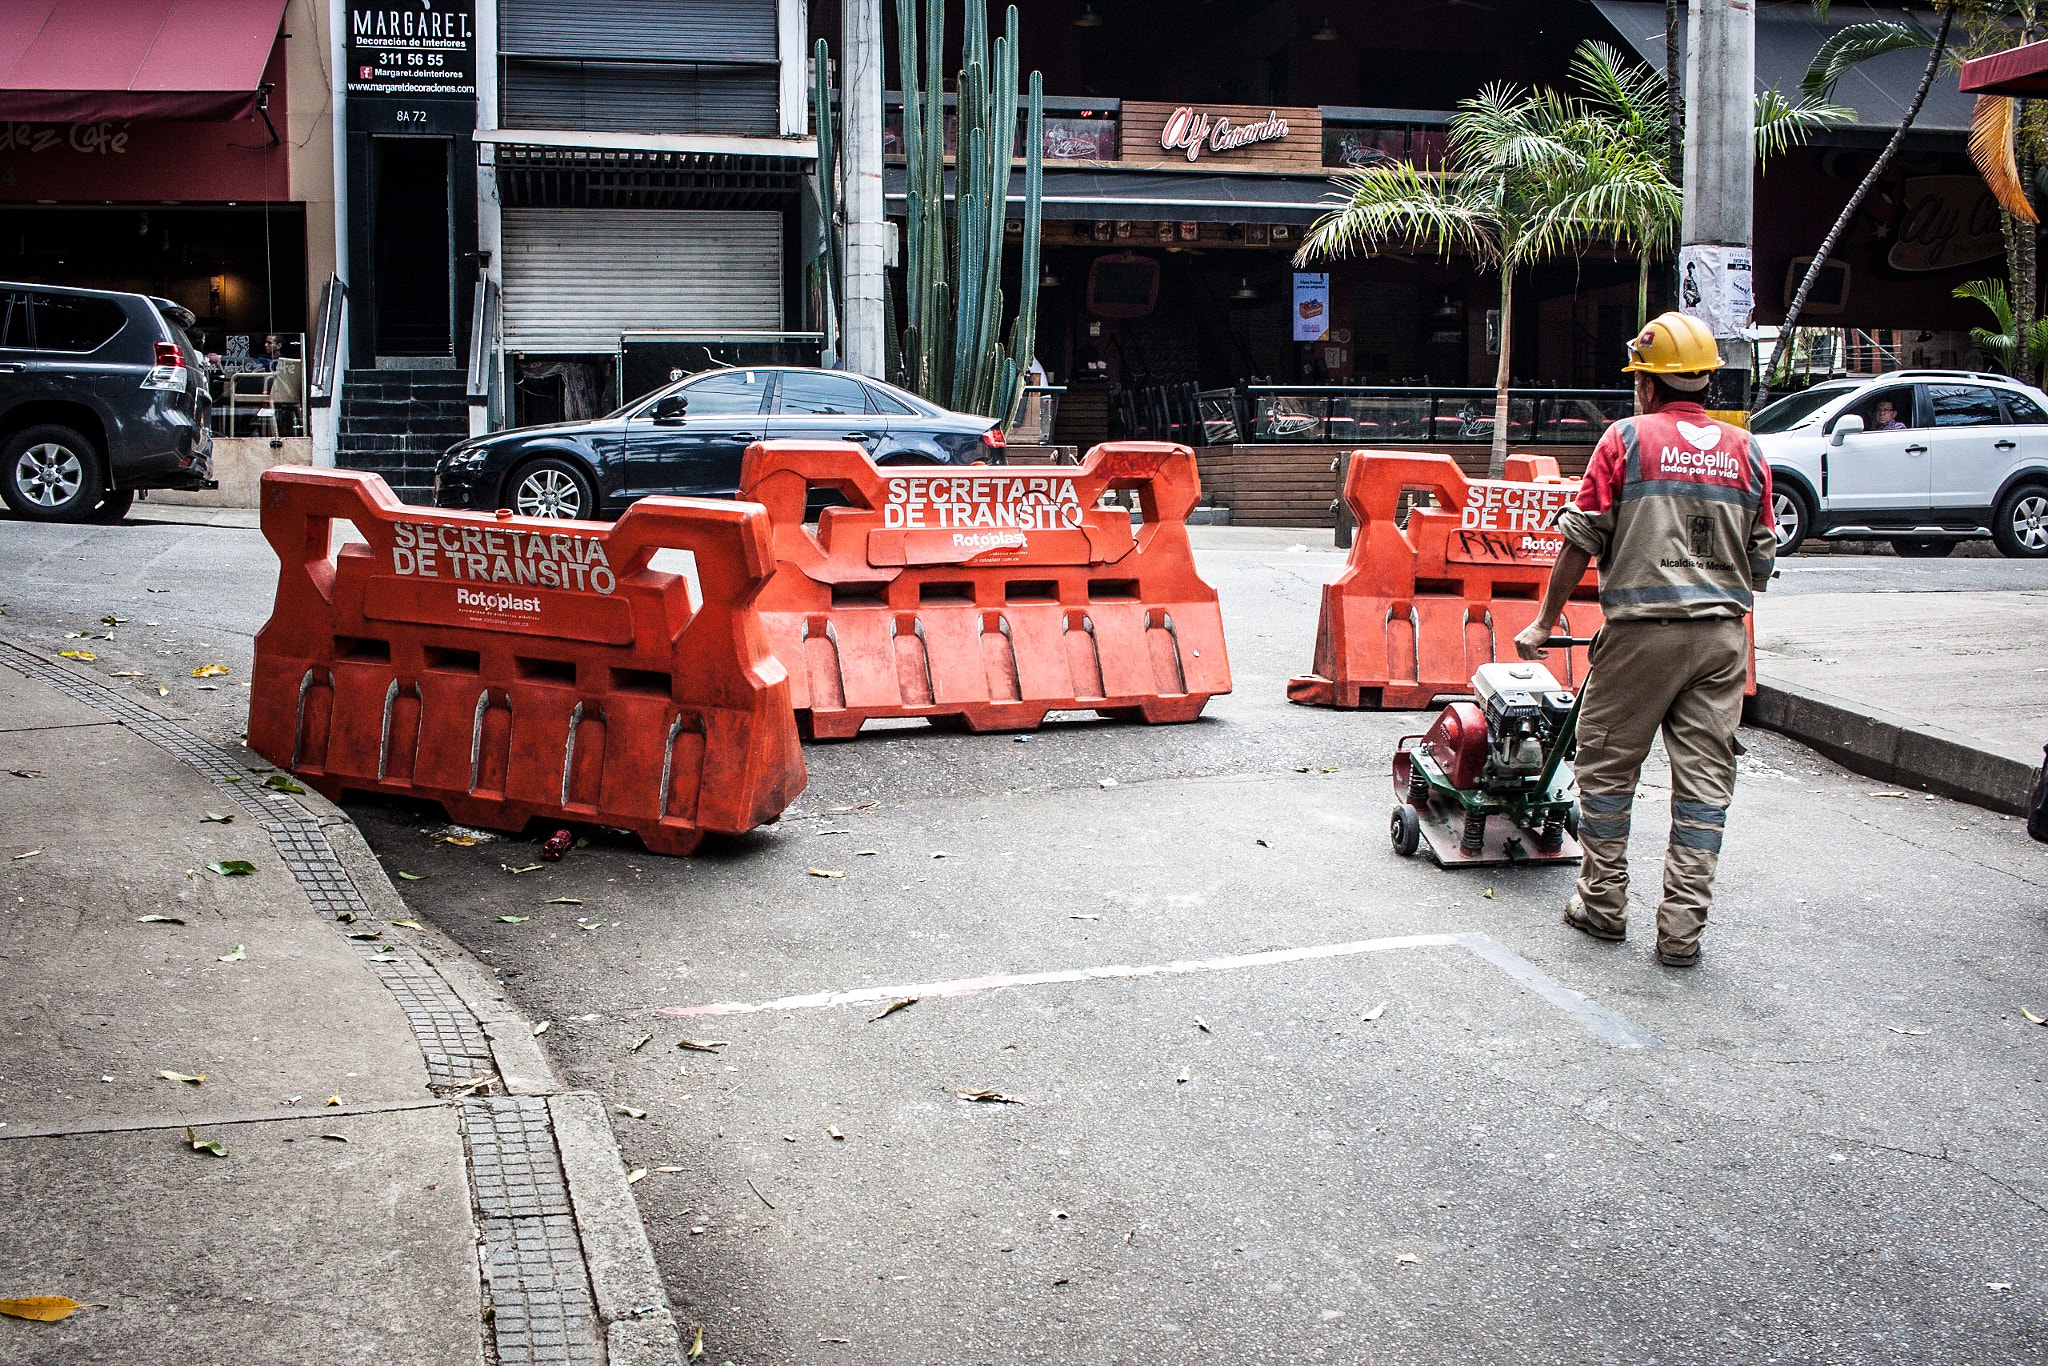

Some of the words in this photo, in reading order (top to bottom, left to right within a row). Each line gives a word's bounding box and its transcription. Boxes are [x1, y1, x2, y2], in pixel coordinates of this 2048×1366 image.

[353, 10, 468, 37] MARGARET
[356, 36, 407, 46] Decoración
[408, 38, 421, 47] de
[422, 38, 467, 48] Interiores
[379, 52, 402, 65] 311
[407, 53, 424, 66] 56
[427, 54, 444, 67] 55
[347, 82, 475, 94] www.margaretdecoraciones.com
[396, 110, 410, 122] 8A
[412, 111, 427, 122] 72
[69, 121, 131, 155] Café
[1161, 106, 1210, 162] Ay
[1209, 110, 1289, 152] Caramba
[1660, 446, 1739, 471] Medellín
[1660, 463, 1688, 473] todos
[1689, 467, 1706, 479] por
[1707, 468, 1717, 476] la
[1719, 469, 1738, 480] vida
[888, 478, 1079, 505] SECRETARIA
[1466, 486, 1577, 511] SECRET
[884, 503, 925, 528] DE
[933, 502, 1084, 530] TRANSITO
[1461, 506, 1499, 530] DE
[394, 521, 609, 567] SECRETARIA
[952, 530, 1028, 549] Rotoplast
[1521, 536, 1563, 554] Rotop
[392, 547, 439, 577] DE
[445, 551, 616, 595] TRANSITO
[457, 588, 541, 613] Rotoplast
